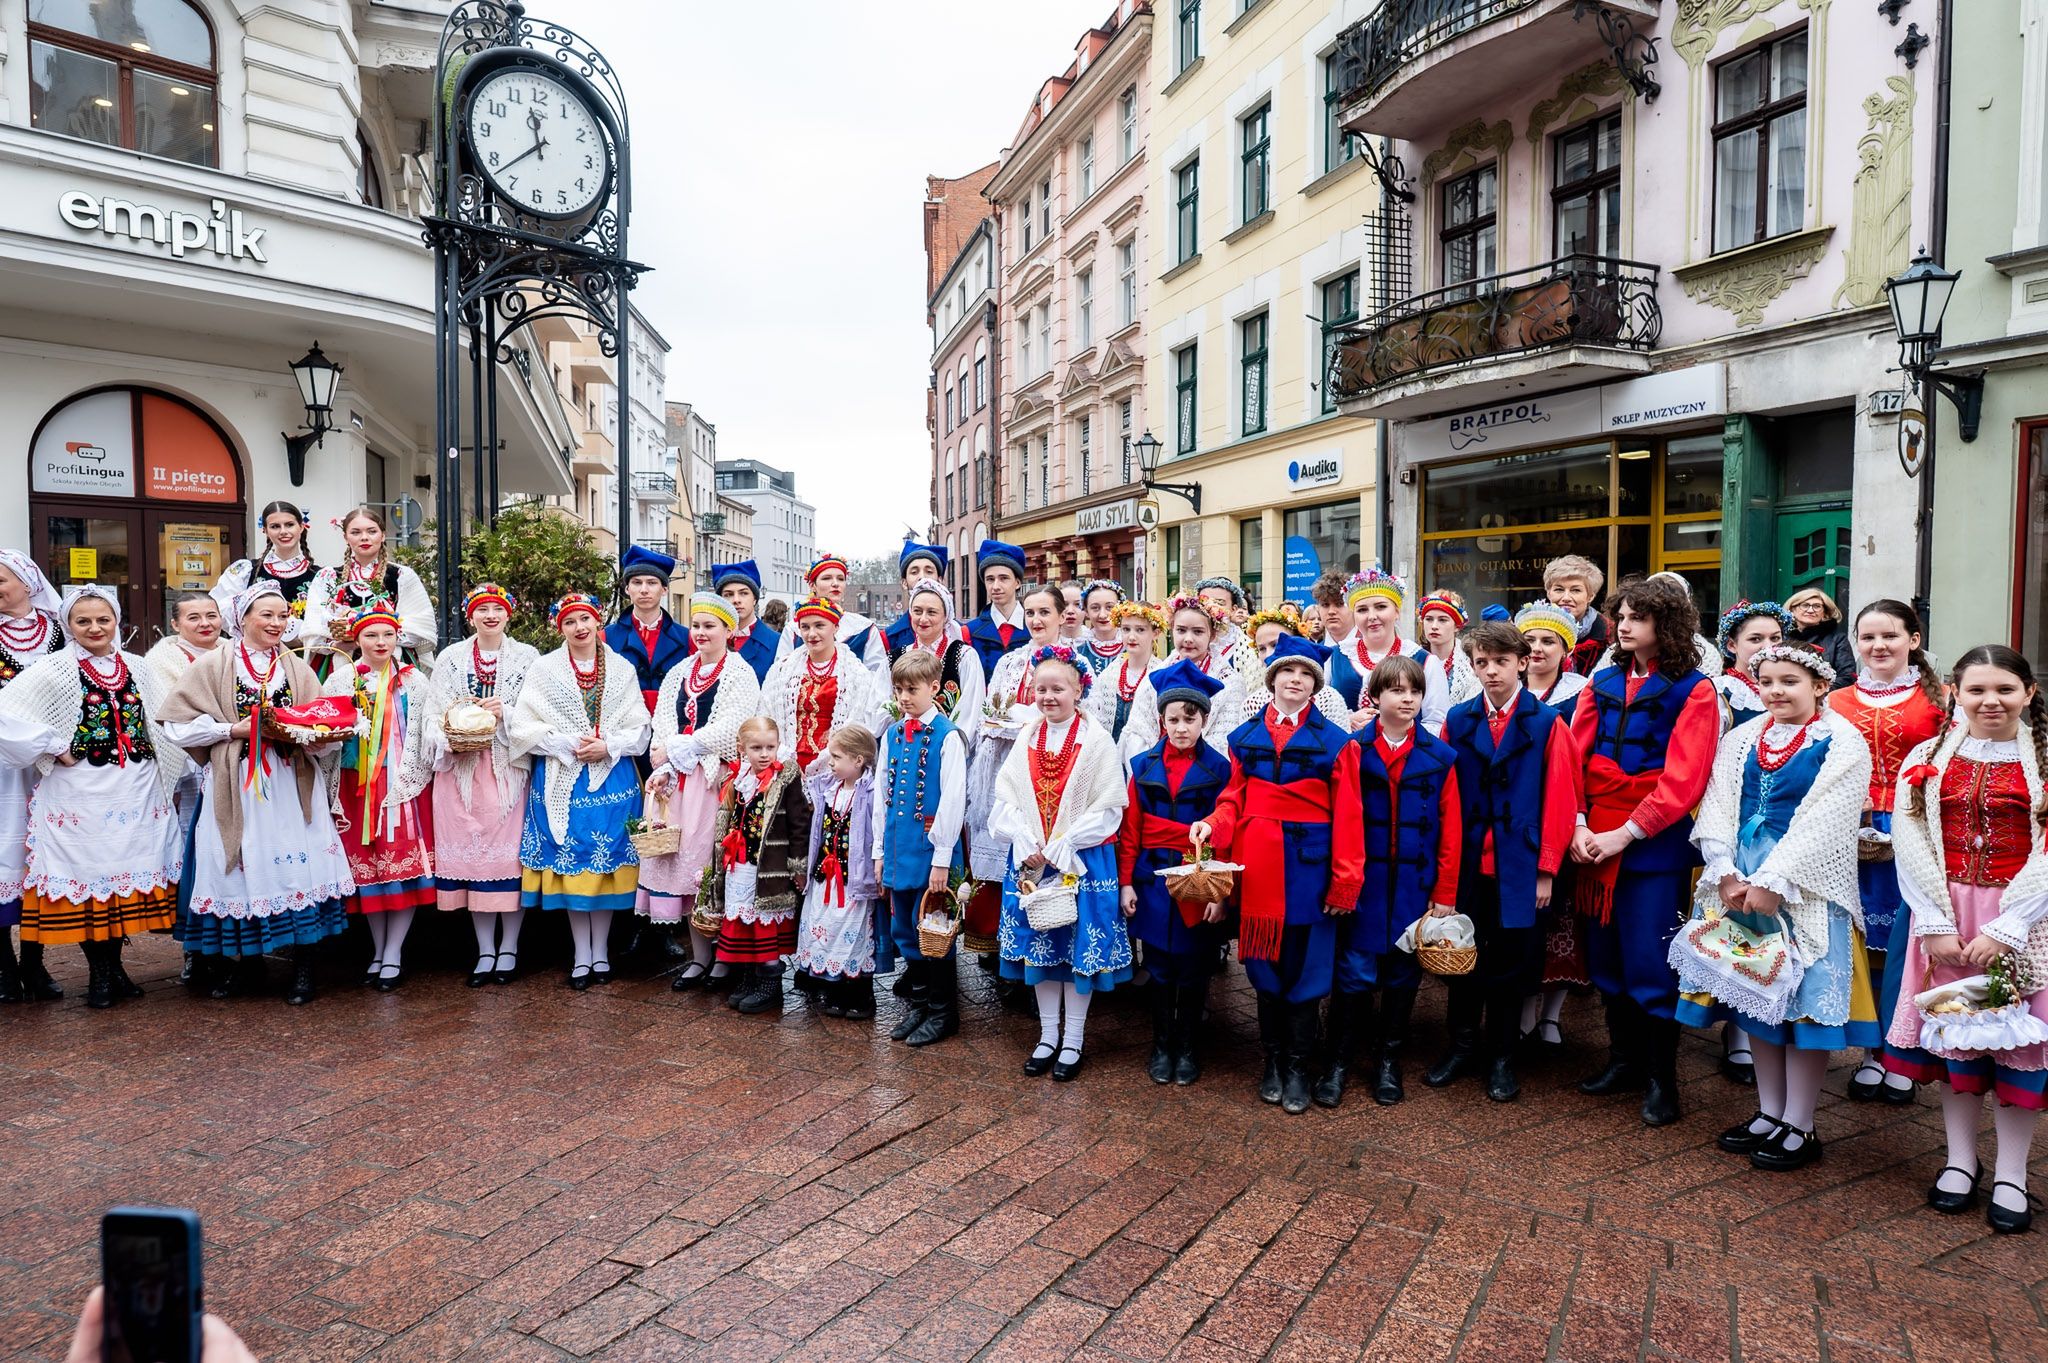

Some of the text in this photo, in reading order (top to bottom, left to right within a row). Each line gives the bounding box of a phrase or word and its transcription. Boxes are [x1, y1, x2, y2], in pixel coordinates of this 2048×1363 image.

[506, 86, 523, 104] 11
[531, 87, 548, 106] 12
[488, 98, 506, 118] 10
[560, 103, 568, 119] 1
[480, 122, 491, 138] 9
[575, 127, 586, 143] 2
[489, 151, 499, 167] 8
[584, 154, 593, 170] 3
[508, 174, 519, 191] 7
[574, 177, 585, 192] 4
[531, 189, 542, 204] 6
[557, 189, 567, 205] 5
[58, 190, 268, 263] empik
[1880, 394, 1901, 410] 17
[1450, 403, 1542, 432] BRATPOL
[1612, 401, 1706, 426] SKLEP MUZYCZNY
[47, 463, 125, 479] ProfiLingua
[153, 467, 226, 486] II piętro
[1301, 459, 1337, 478] Audika
[153, 482, 225, 495] www.profilingua.pl
[1078, 504, 1130, 531] MAXI STYL
[1437, 561, 1471, 574] PIANO
[1480, 559, 1523, 571] GITARY
